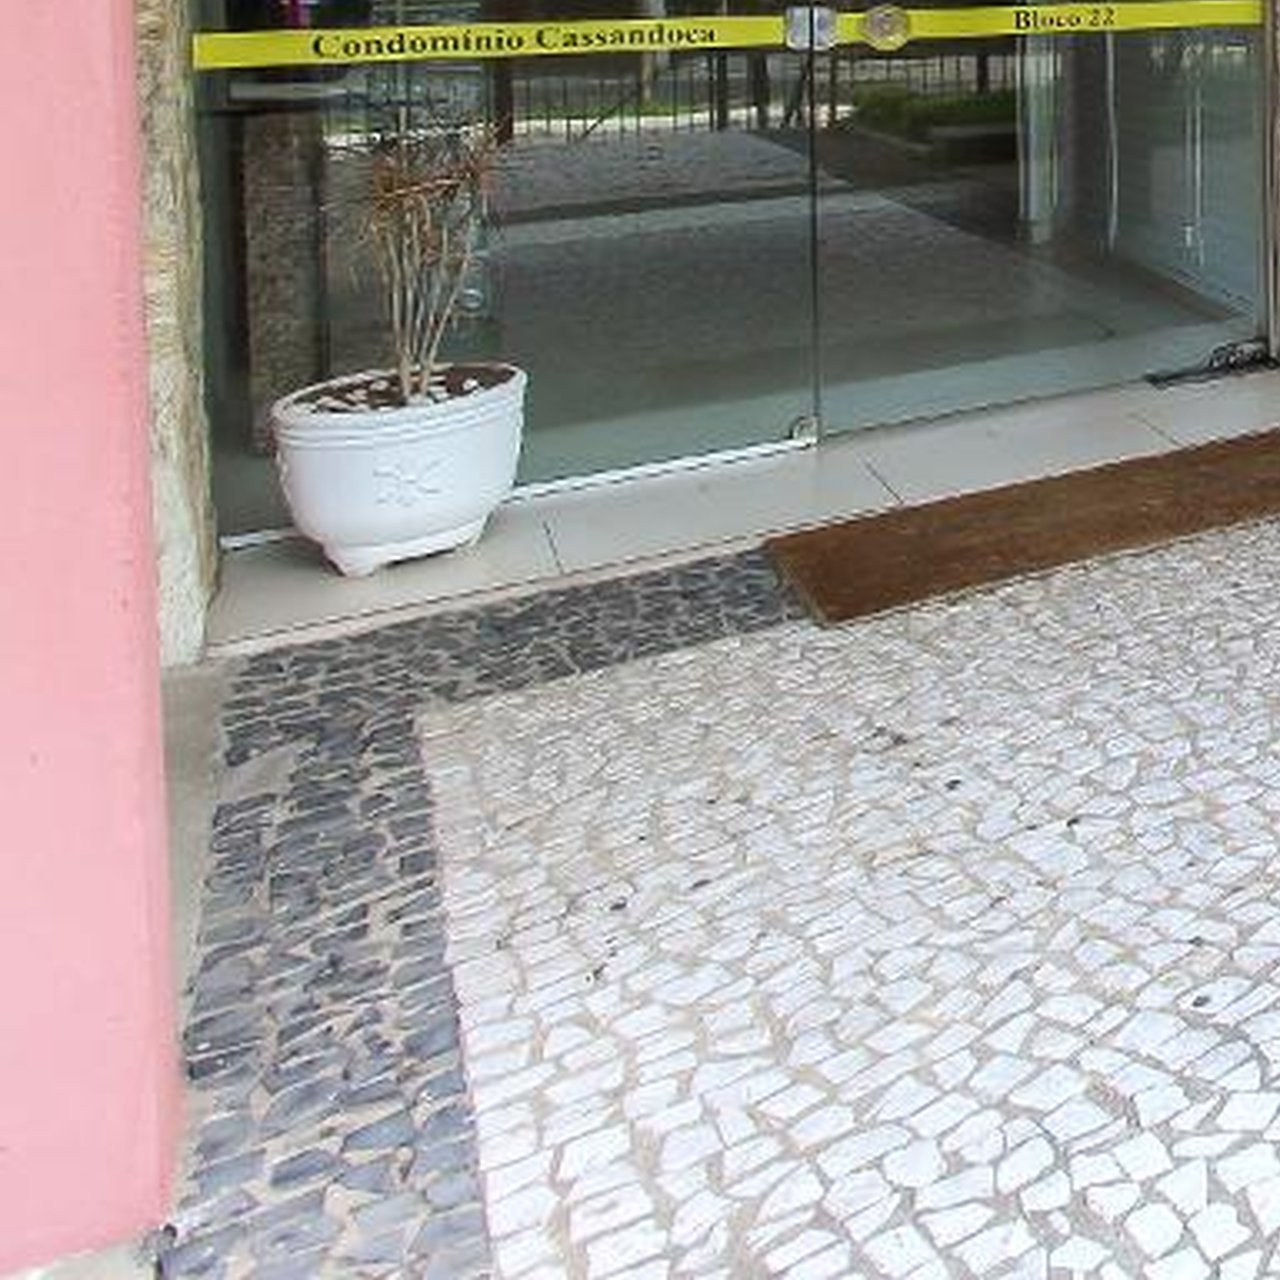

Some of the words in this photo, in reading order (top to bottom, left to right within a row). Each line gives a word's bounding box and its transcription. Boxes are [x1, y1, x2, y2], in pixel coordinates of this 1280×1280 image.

[1014, 10, 1082, 31] Bloco
[1088, 7, 1115, 27] 22
[312, 29, 524, 58] Condomínio
[536, 24, 716, 49] Cassandoca
